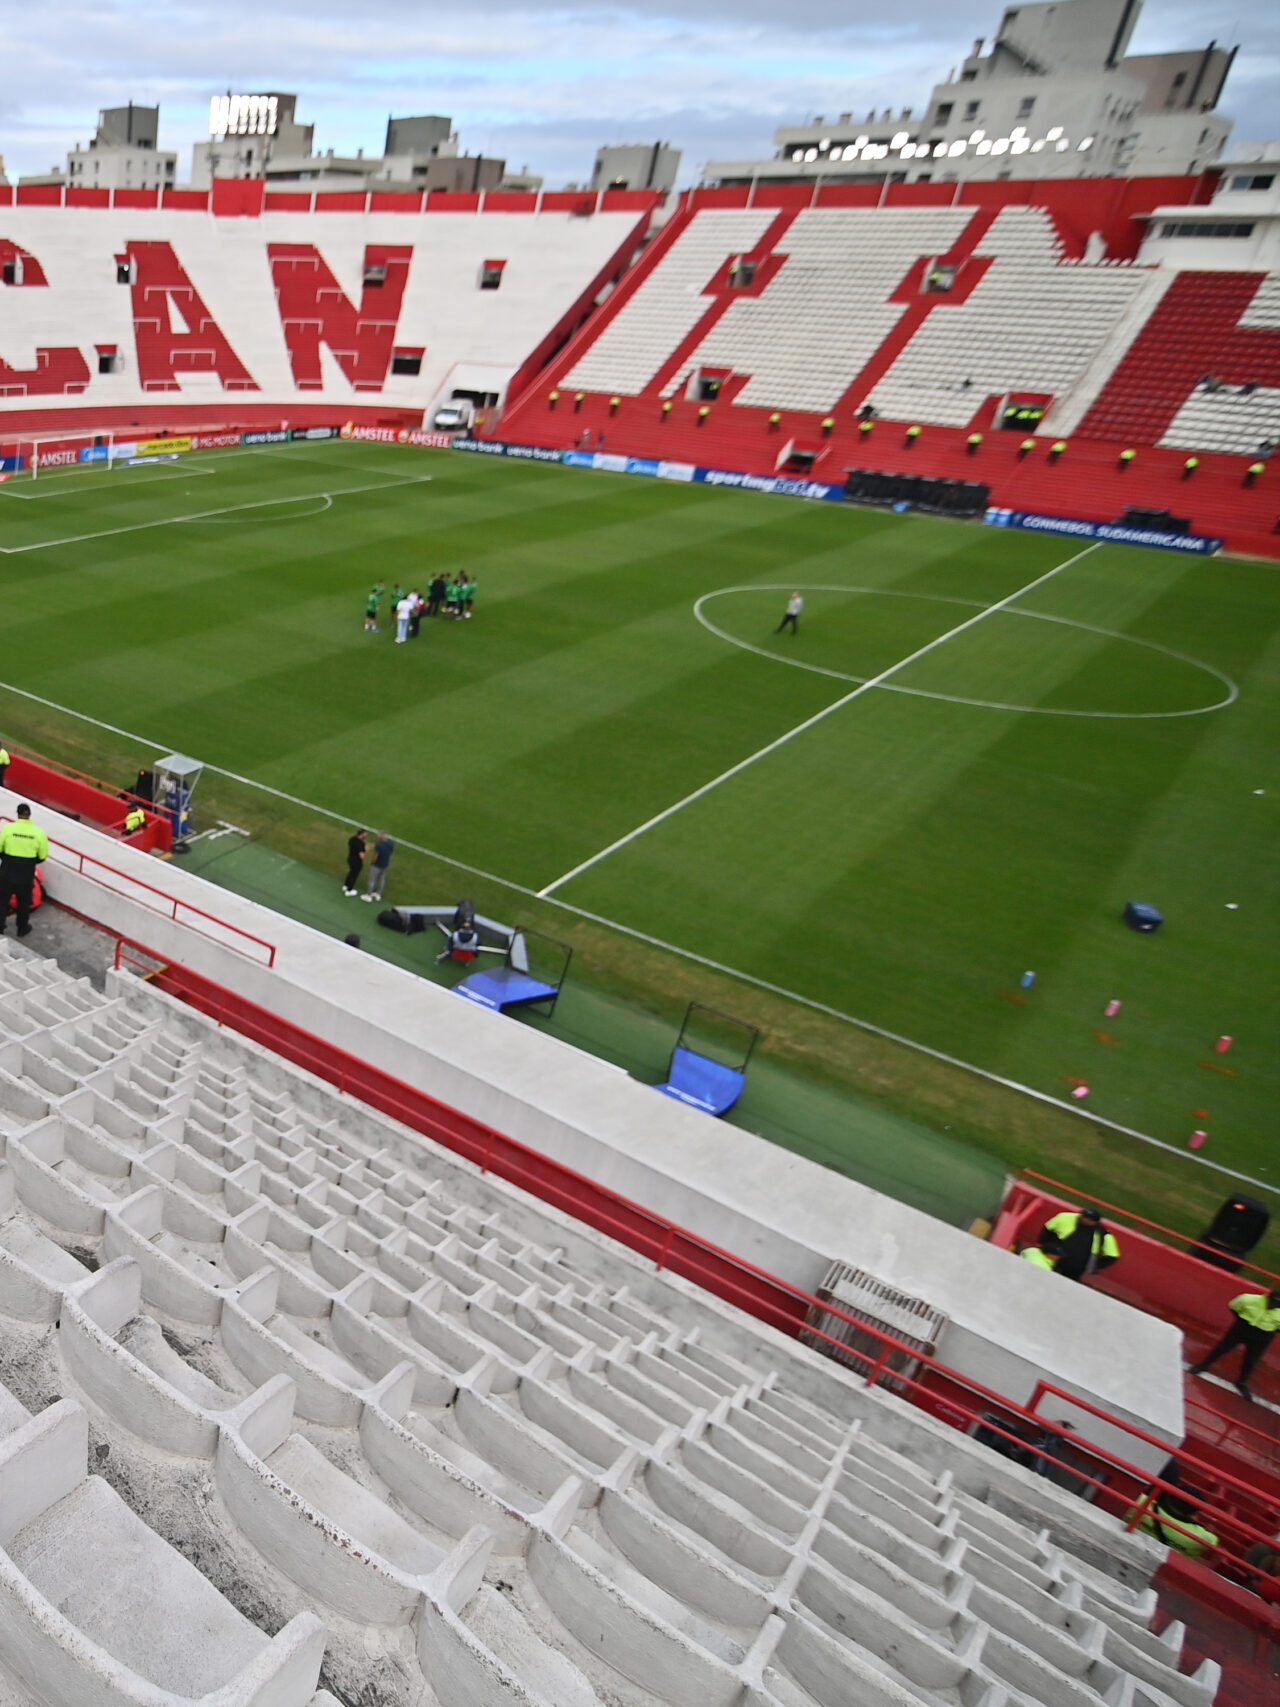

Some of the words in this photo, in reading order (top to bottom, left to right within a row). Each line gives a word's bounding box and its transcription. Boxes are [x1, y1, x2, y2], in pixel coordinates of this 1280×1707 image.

[352, 426, 395, 442] AMSTEL
[408, 430, 450, 448] AMSTEL
[40, 451, 77, 467] AMSTEL
[1022, 514, 1093, 536] CONMEBOL
[1095, 524, 1205, 551] SUDAMERICANA
